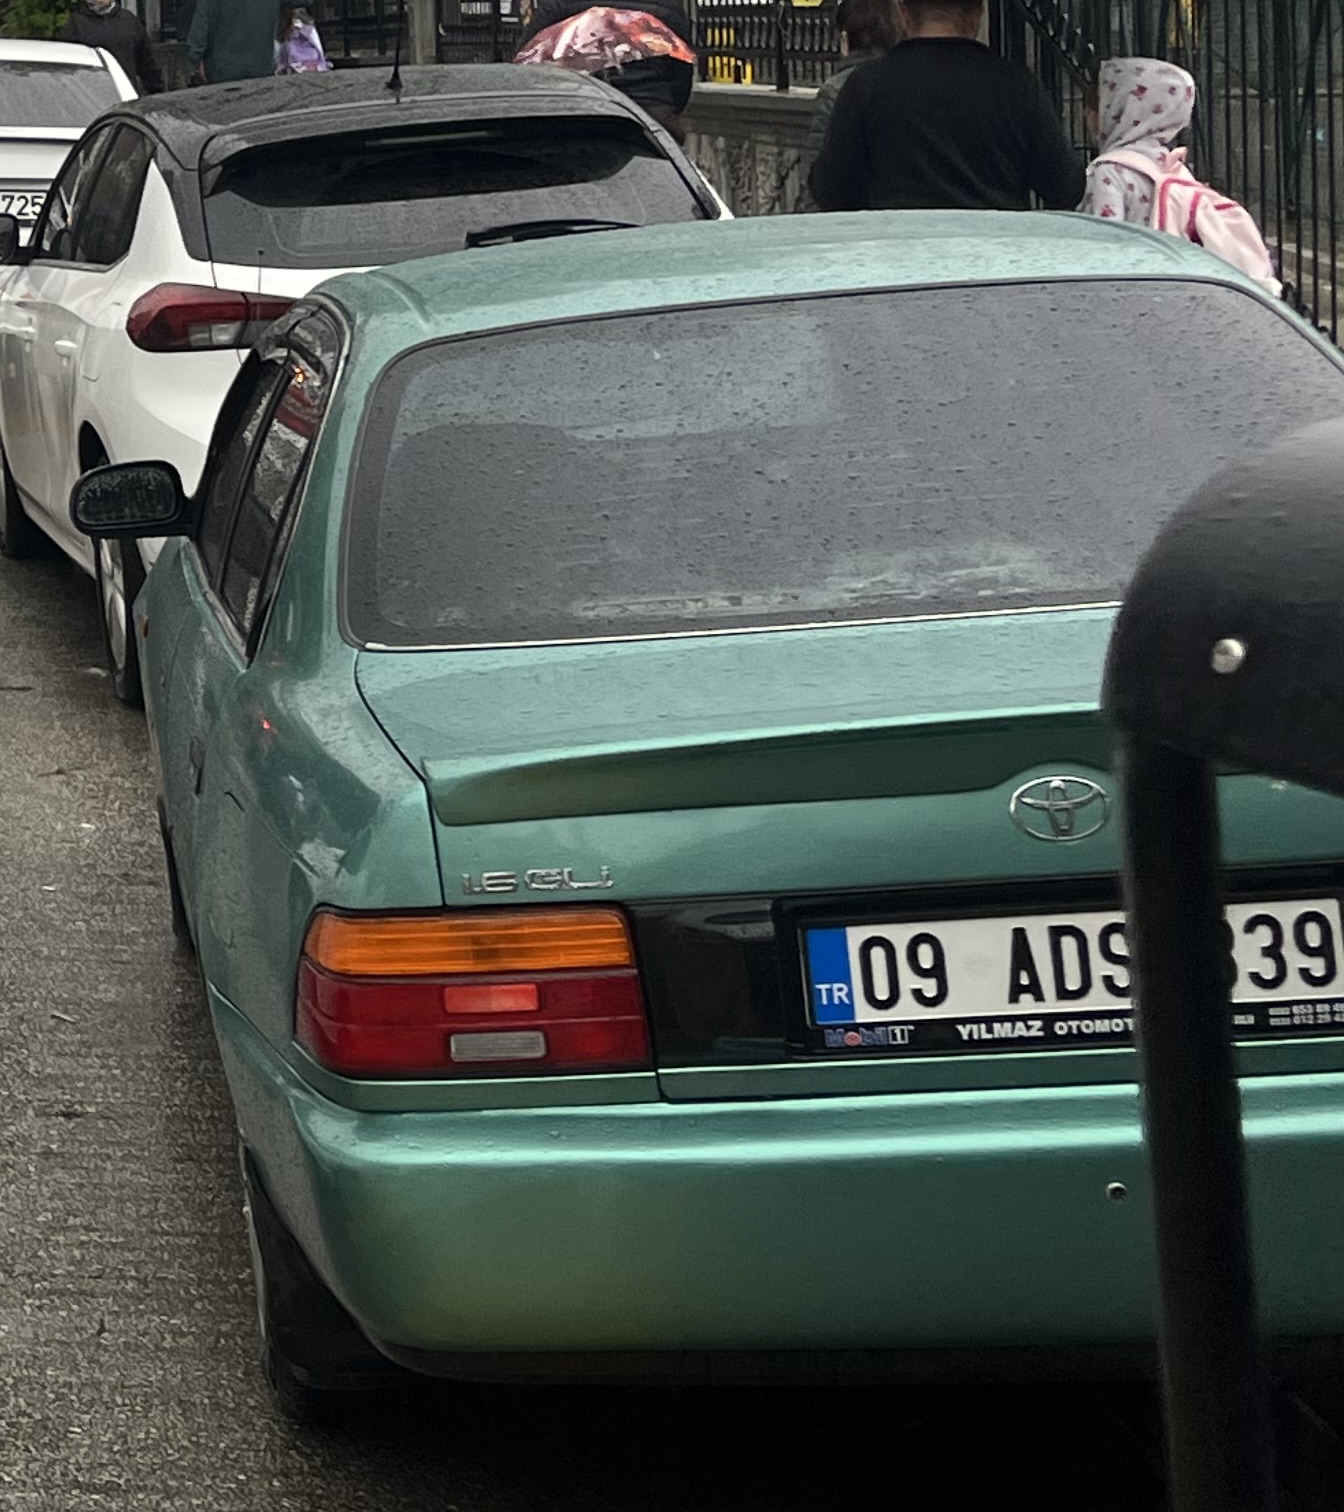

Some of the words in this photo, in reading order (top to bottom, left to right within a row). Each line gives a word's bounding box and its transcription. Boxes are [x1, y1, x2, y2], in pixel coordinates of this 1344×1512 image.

[1, 194, 45, 218] 725
[815, 983, 850, 1006] TR
[858, 930, 949, 1011] 09
[1007, 920, 1133, 1006] ADS
[955, 1020, 1045, 1041] YILMAZ
[1053, 1017, 1135, 1036] OTOMOT
